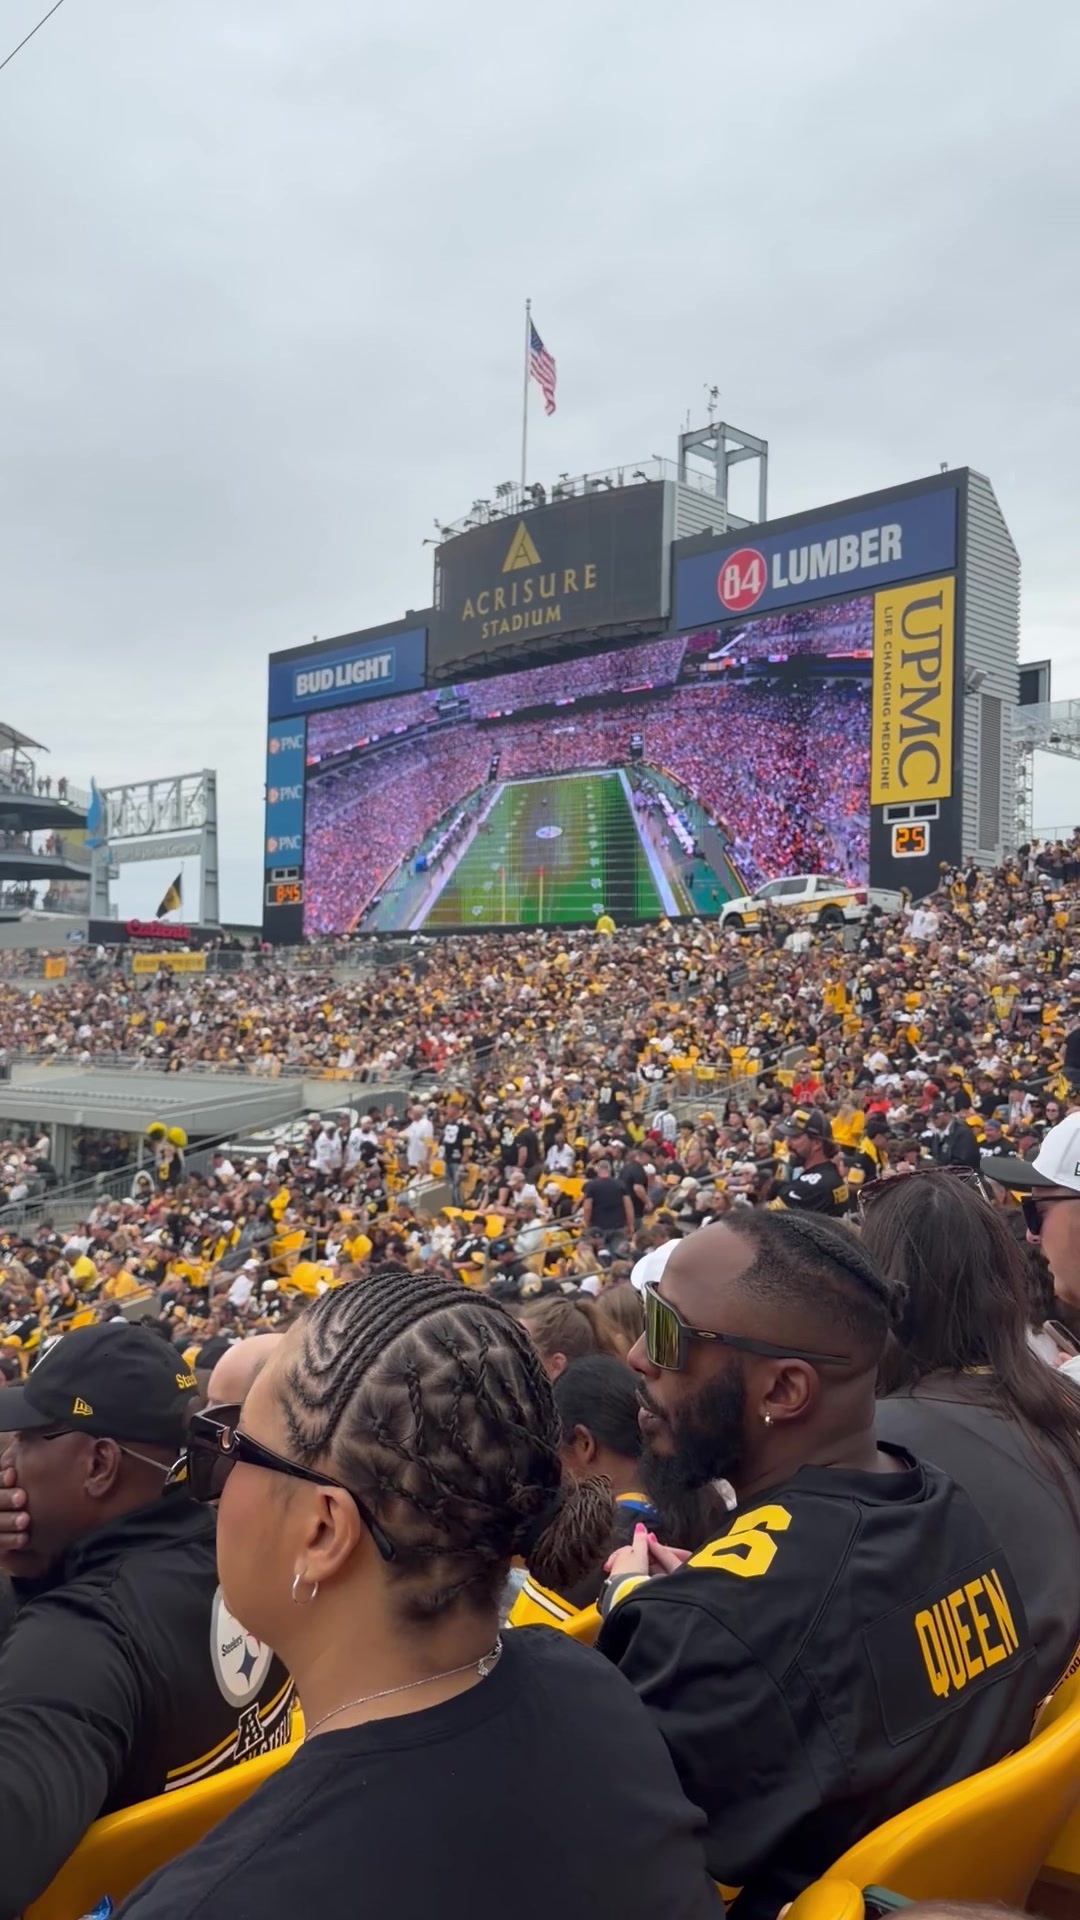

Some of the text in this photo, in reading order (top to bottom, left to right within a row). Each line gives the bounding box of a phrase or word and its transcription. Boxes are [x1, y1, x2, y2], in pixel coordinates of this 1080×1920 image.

[723, 523, 902, 600] 84 LUMBER
[462, 564, 597, 621] ACRISURE
[482, 604, 561, 639] STADIUM
[296, 654, 391, 697] BUD LIGHT
[898, 590, 943, 788] UPMC
[880, 606, 893, 790] LIFE CHANGING MEDICINE
[281, 734, 304, 751] PNC
[280, 784, 303, 800] PNC
[278, 834, 302, 850] PNC
[895, 826, 924, 853] 25
[687, 1504, 792, 1577] 6
[221, 1635, 243, 1657] Steelers
[914, 1568, 1019, 1698] QUEEN
